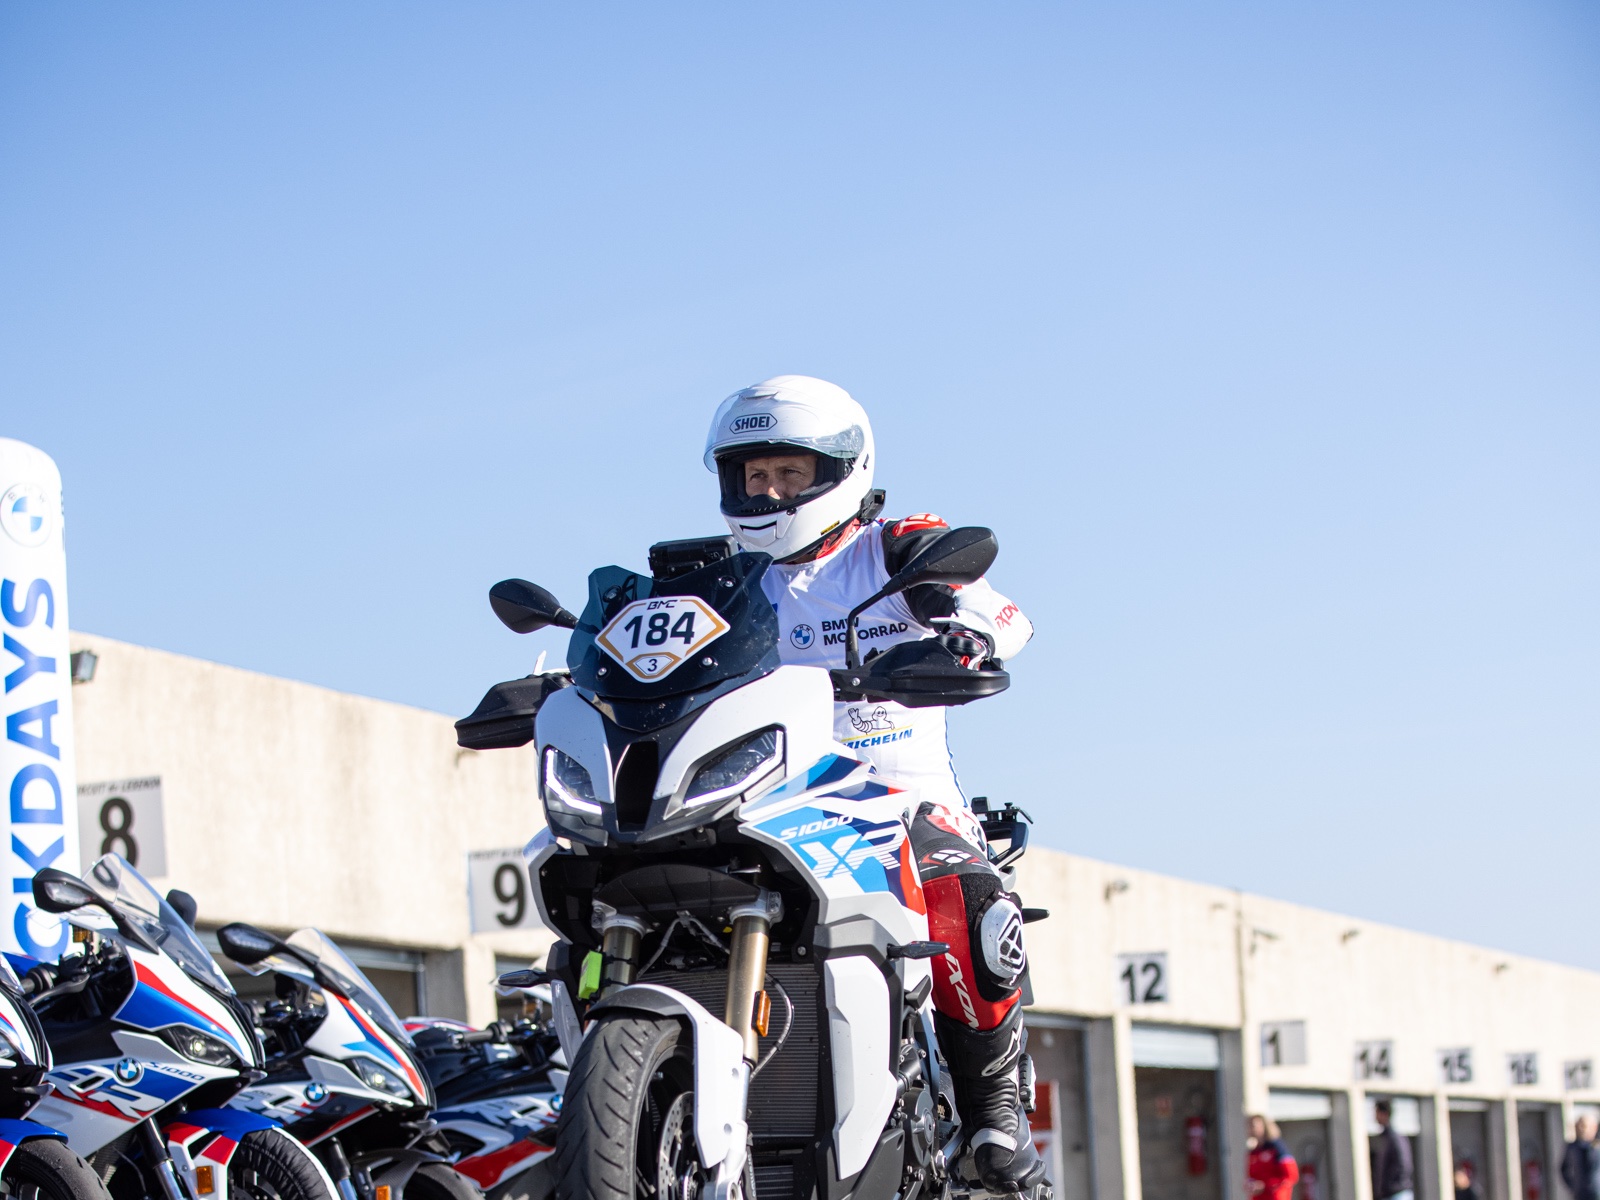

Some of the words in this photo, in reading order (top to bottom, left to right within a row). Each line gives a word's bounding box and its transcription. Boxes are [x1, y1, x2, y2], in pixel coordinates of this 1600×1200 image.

[734, 415, 771, 432] SHOEI
[647, 599, 678, 611] BMC
[624, 611, 697, 649] 184
[823, 622, 909, 646] MOORRAD
[647, 658, 658, 673] 3
[99, 797, 138, 869] 8
[779, 815, 855, 842] S1000
[799, 824, 902, 880] XR
[493, 862, 527, 928] 9
[1121, 962, 1165, 1003] 12
[1359, 1049, 1391, 1080] 14
[1442, 1052, 1472, 1083] 15
